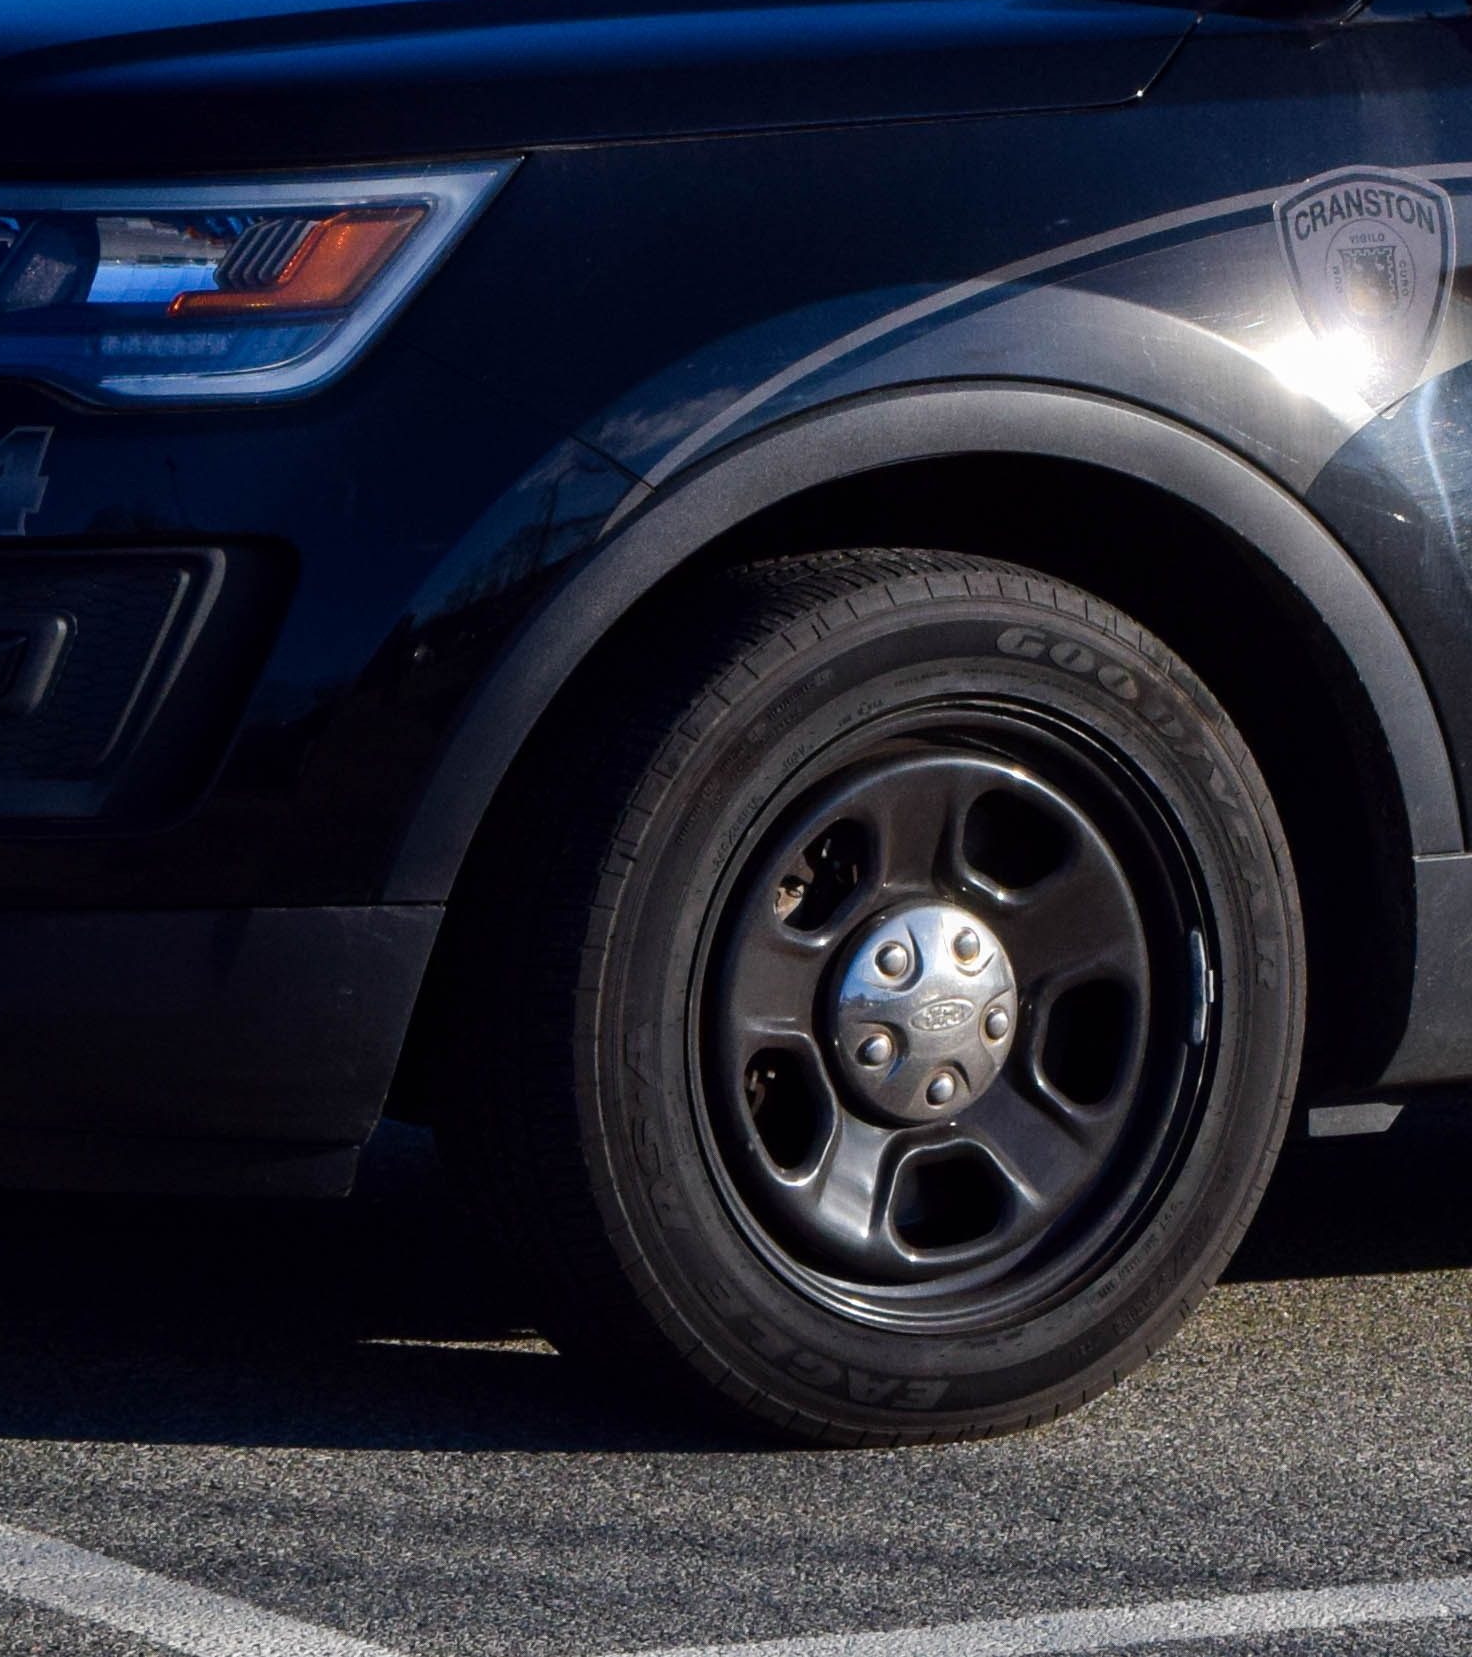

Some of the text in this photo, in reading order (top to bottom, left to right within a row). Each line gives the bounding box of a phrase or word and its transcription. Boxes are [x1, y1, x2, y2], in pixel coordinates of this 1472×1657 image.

[1294, 188, 1436, 241] CRANSTON
[995, 625, 1281, 991] GOODYEAR
[700, 1278, 952, 1412] EAGLE
